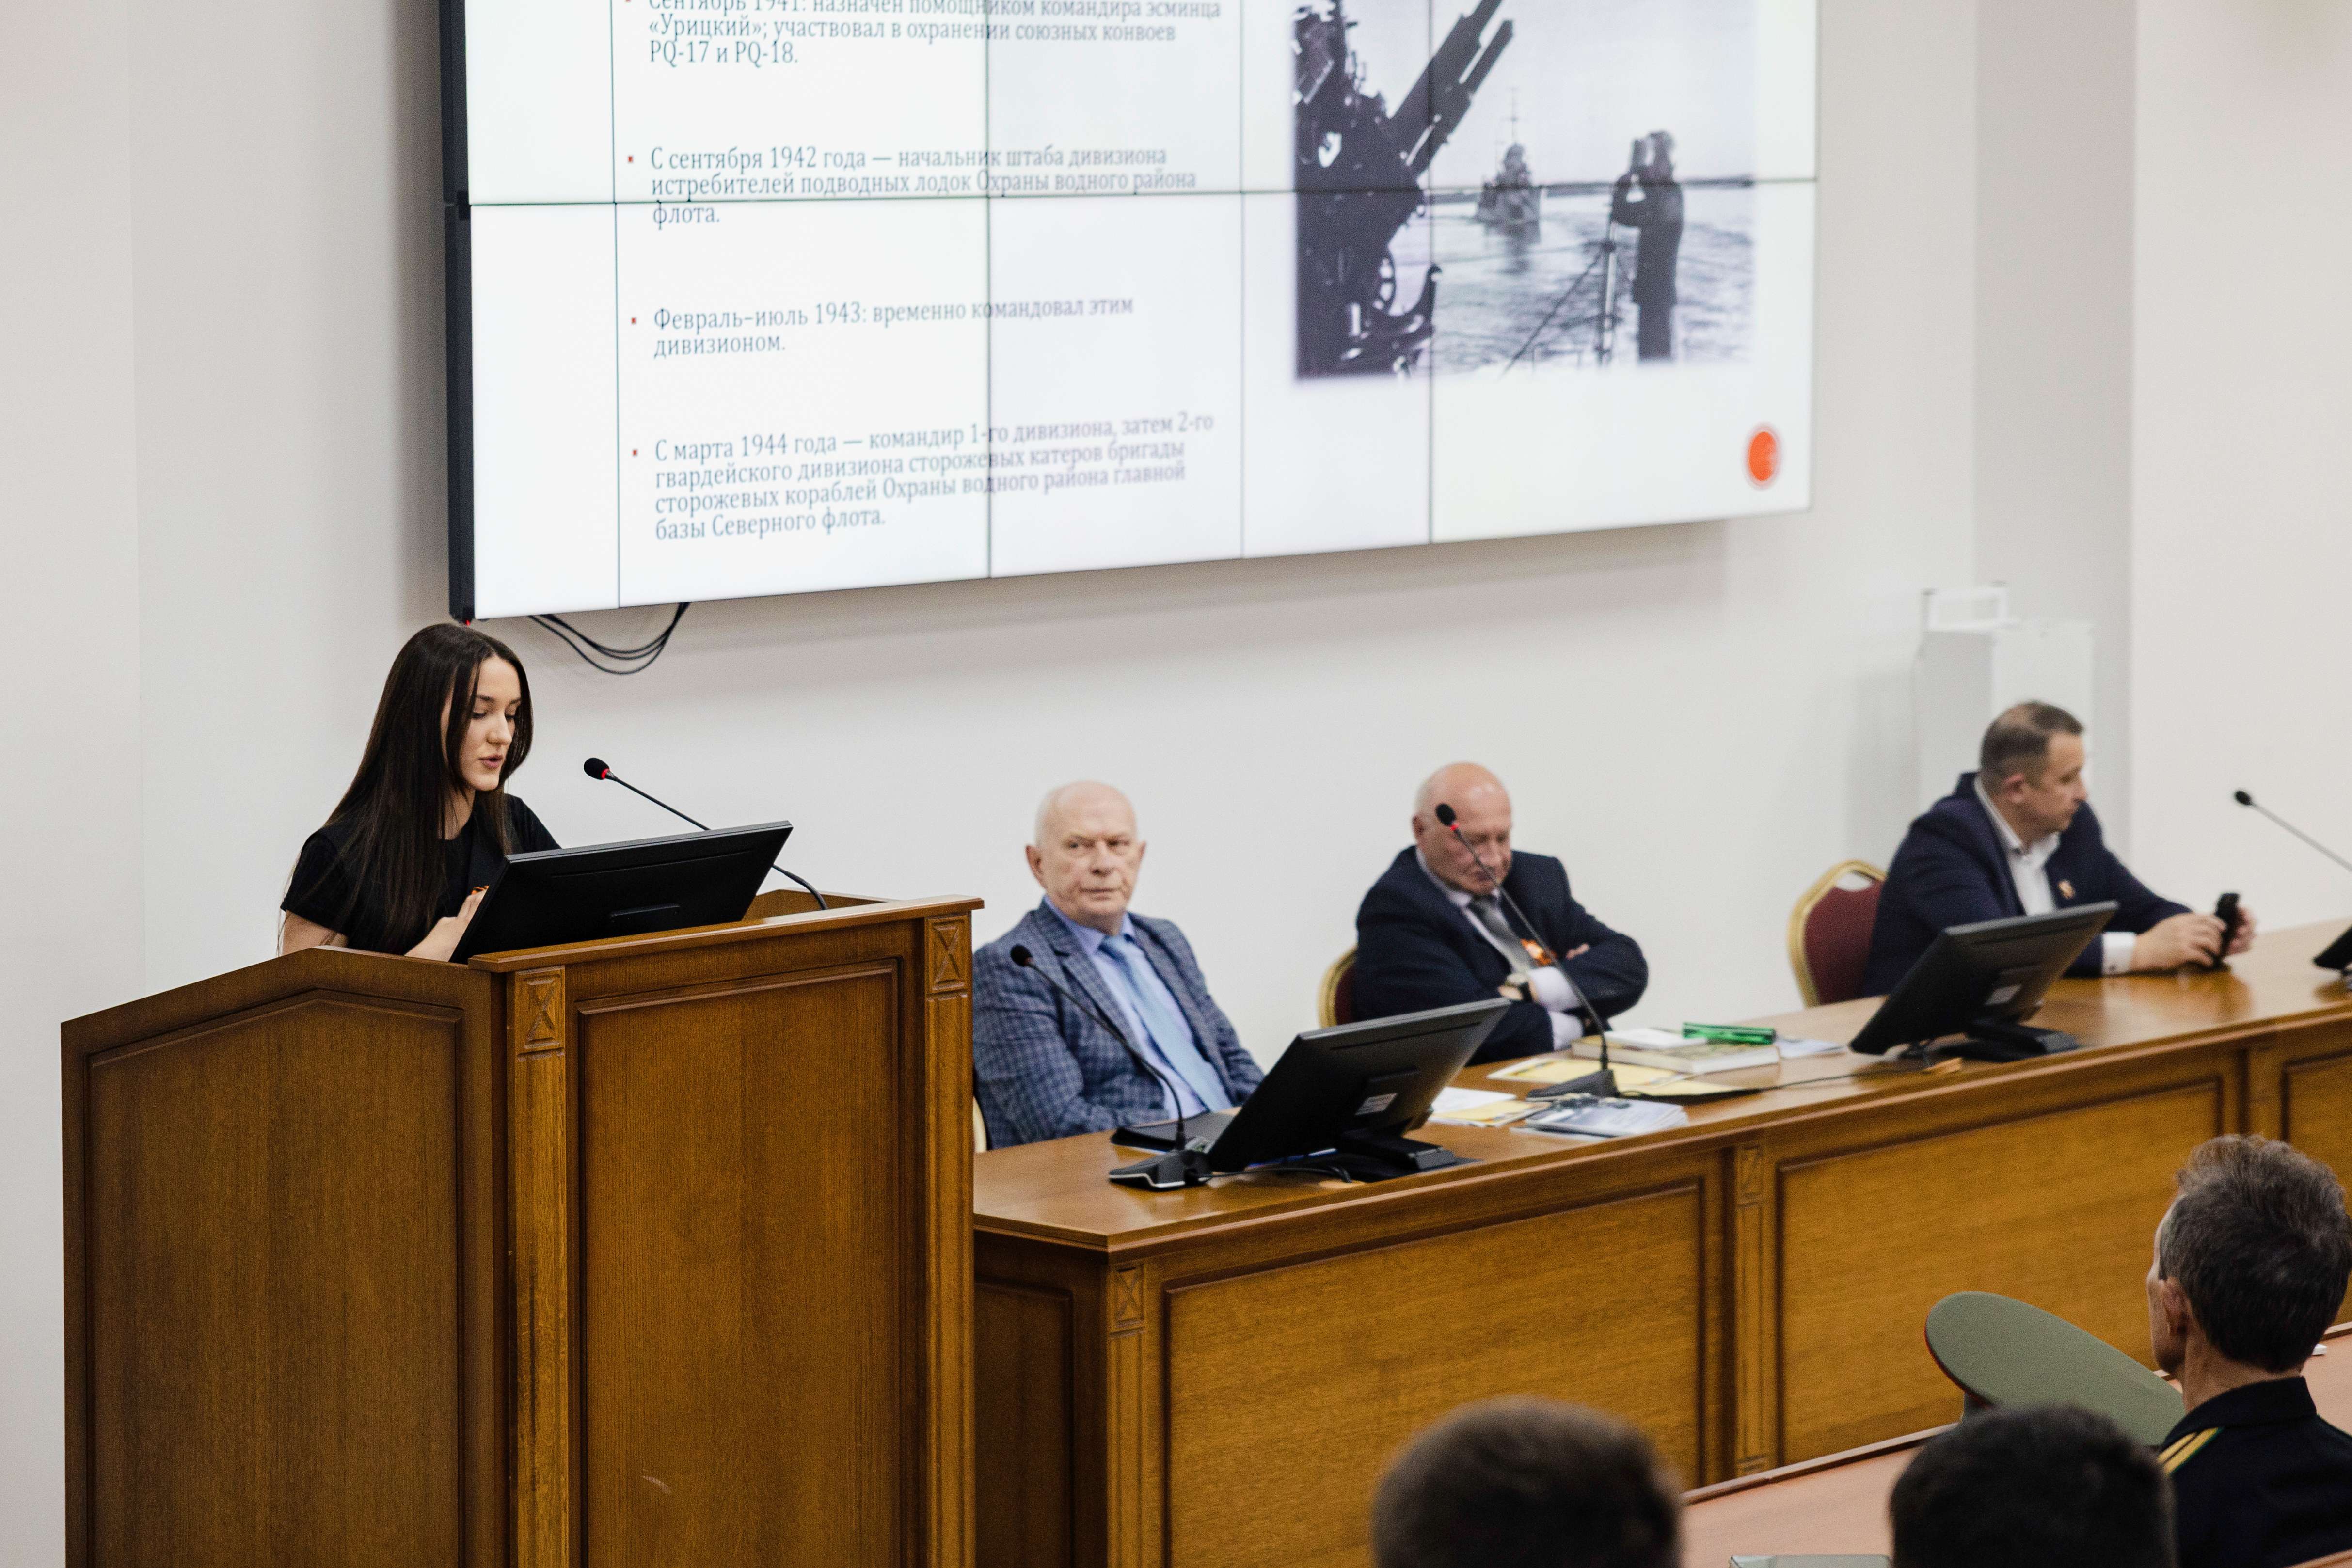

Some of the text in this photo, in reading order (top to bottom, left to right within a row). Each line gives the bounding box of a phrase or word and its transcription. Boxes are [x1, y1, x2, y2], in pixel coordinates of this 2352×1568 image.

[813, 0, 903, 13] назначен
[1041, 0, 1141, 22] командира
[774, 20, 885, 43] участвовал
[891, 23, 902, 38] в
[906, 22, 1010, 44] охранении
[1015, 25, 1097, 41] союзных
[1102, 25, 1176, 41] конвоев
[650, 40, 799, 68] PQ-17 и PQ-18.
[669, 146, 763, 175] сентября
[770, 146, 817, 169] 1942
[823, 151, 866, 171] года
[898, 150, 1001, 167] начальник
[1006, 144, 1064, 167] штаба
[1068, 147, 1167, 168] дивизиона
[652, 168, 1196, 202] истребителей подводных лодок Охраны водного района
[652, 200, 721, 230] флота.
[815, 301, 867, 325] 1943:
[873, 302, 967, 328] временно
[971, 300, 1083, 321] командовал
[1089, 297, 1133, 316] этим
[654, 336, 786, 359] дивизионом.
[674, 442, 733, 465] марта
[741, 433, 788, 457] 1944
[794, 435, 837, 456] года
[869, 428, 964, 450] командир
[971, 422, 1008, 444] 1-го
[1122, 417, 1173, 436] затем
[1177, 411, 1214, 433] 2-го
[656, 438, 1185, 493] гвардейского дивизиона сторожевых катеров бригады
[656, 459, 1186, 518] сторожевых кораблей Охраны водного района главной
[655, 506, 886, 540] базы Северного флота.
